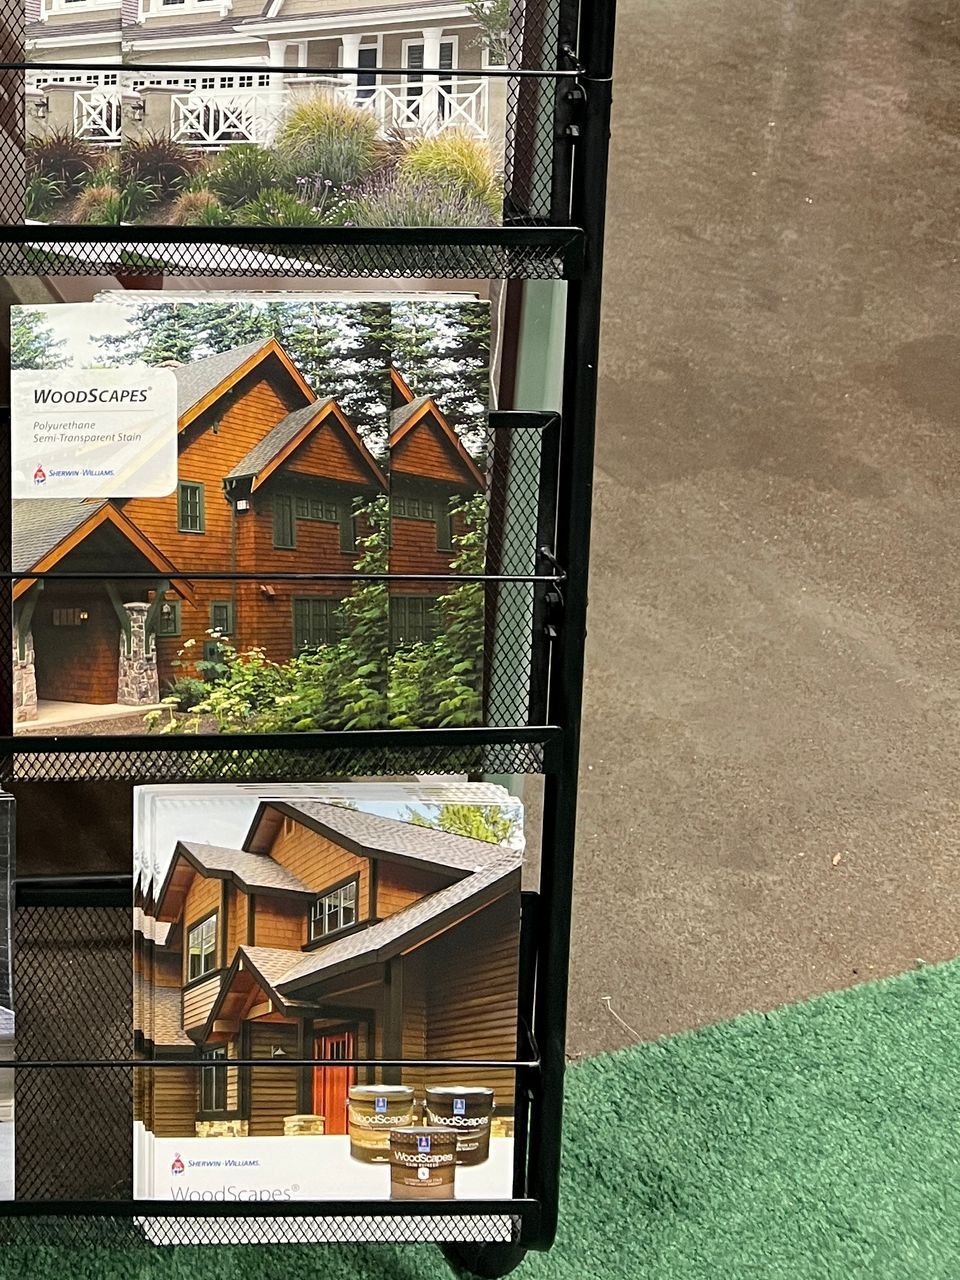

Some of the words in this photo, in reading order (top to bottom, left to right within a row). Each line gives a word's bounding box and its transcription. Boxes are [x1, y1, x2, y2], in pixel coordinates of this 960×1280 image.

[33, 421, 96, 431] Polyurethane
[33, 433, 115, 443] Semi-Transparent
[117, 433, 142, 442] Stain
[352, 1113, 410, 1125] WoodScapes
[430, 1114, 489, 1127] WoodScapes
[394, 1151, 454, 1164] WoodScapes
